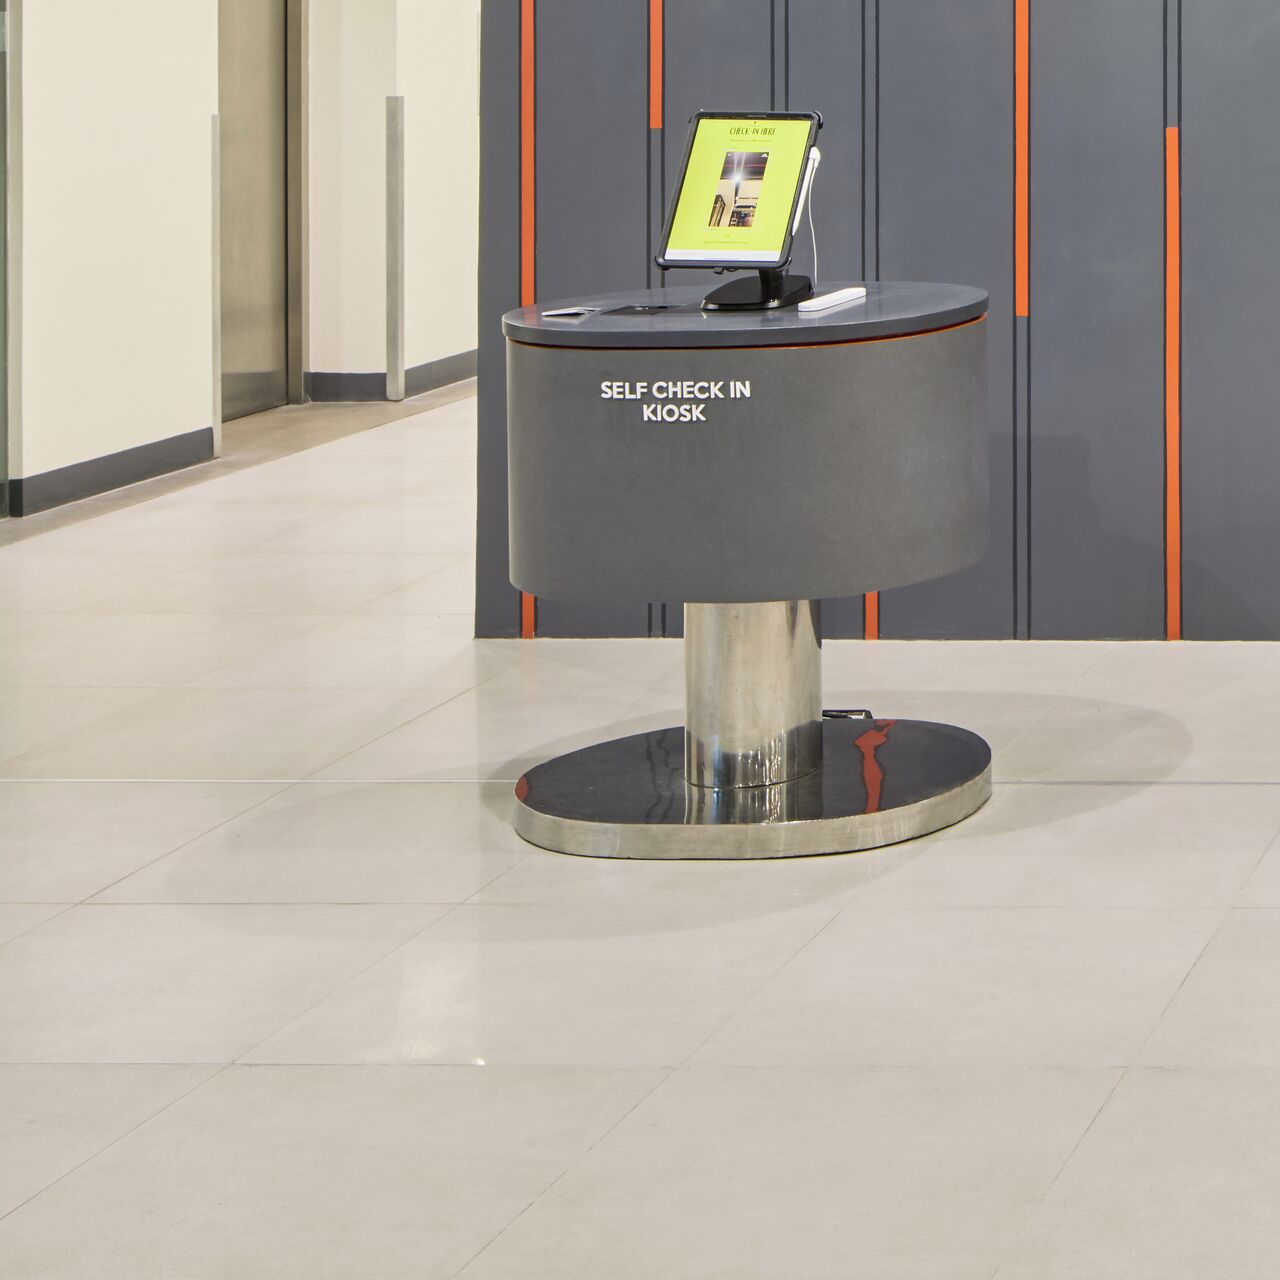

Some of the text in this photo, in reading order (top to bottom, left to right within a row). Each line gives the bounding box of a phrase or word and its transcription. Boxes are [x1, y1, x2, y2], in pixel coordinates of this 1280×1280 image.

[600, 380, 751, 399] SELF CHECK IN
[642, 403, 707, 422] KIOSK
